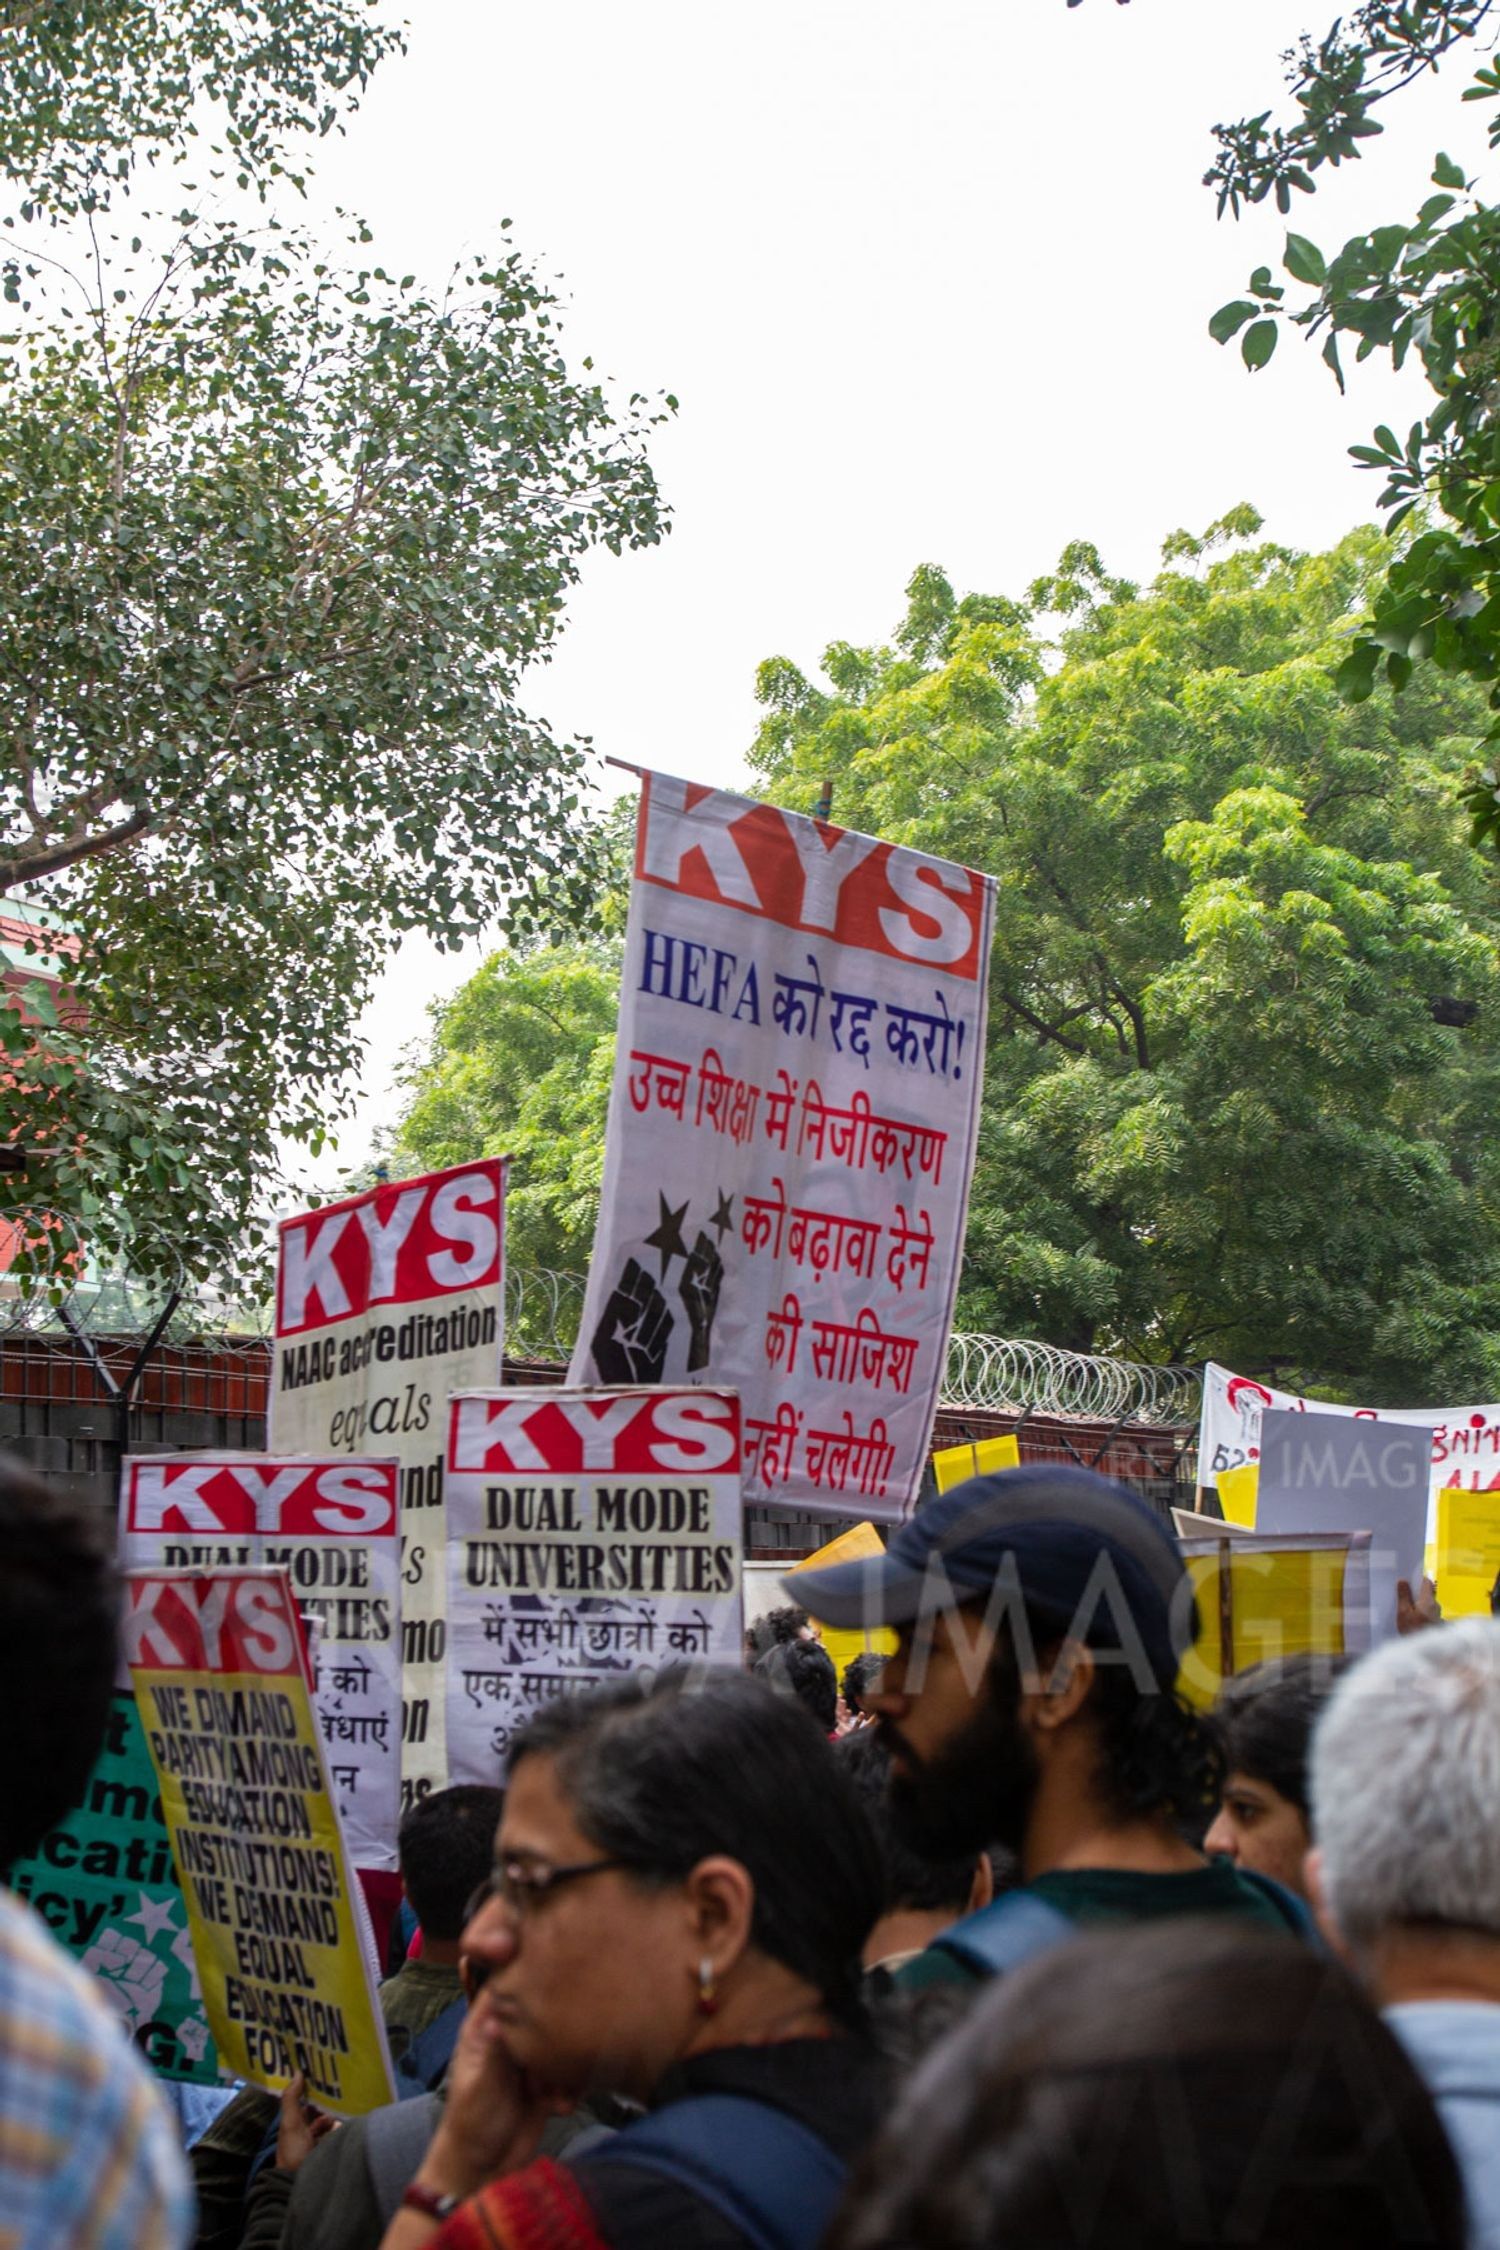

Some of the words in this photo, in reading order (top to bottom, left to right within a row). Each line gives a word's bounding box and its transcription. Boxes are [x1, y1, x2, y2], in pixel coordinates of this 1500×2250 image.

[643, 772, 973, 964] KYS
[637, 929, 761, 1026] HEFA
[772, 954, 826, 1042] को
[886, 992, 965, 1080] करो!
[629, 1050, 691, 1121] उच्च
[694, 1048, 759, 1147] शिक्षा
[765, 1070, 799, 1151] में
[798, 1080, 948, 1186] निजीकरण
[281, 1172, 498, 1330] KYS
[741, 1178, 787, 1259] को
[886, 1204, 935, 1293] देने
[280, 1336, 337, 1391] NAAC
[339, 1305, 496, 1378] accreditation
[766, 1293, 803, 1374] की
[811, 1309, 919, 1393] साजिश
[329, 1383, 432, 1453] equals
[454, 1395, 736, 1471] KYS
[743, 1402, 804, 1490] नहीं
[806, 1410, 896, 1497] चलेगी!
[134, 1466, 392, 1533] KYS
[485, 1487, 582, 1532] DUAL
[596, 1487, 710, 1533] MODE
[465, 1541, 734, 1594] UNIVERSITIES
[127, 1578, 294, 1672] KYS
[481, 1603, 504, 1648] में
[513, 1608, 578, 1651] सभी
[666, 1609, 712, 1653] को
[151, 1686, 192, 1730] WE
[462, 1671, 512, 1708] एक
[151, 1732, 226, 1781] PARITY
[230, 1740, 321, 1793] AMONG
[181, 1780, 312, 1840] EDUCATION
[192, 1877, 231, 1925] WE
[234, 1885, 339, 1947] DEMAND
[234, 1931, 315, 1989] EQUAL
[225, 1975, 348, 2053] EDUCATION
[244, 2027, 294, 2078] FOR
